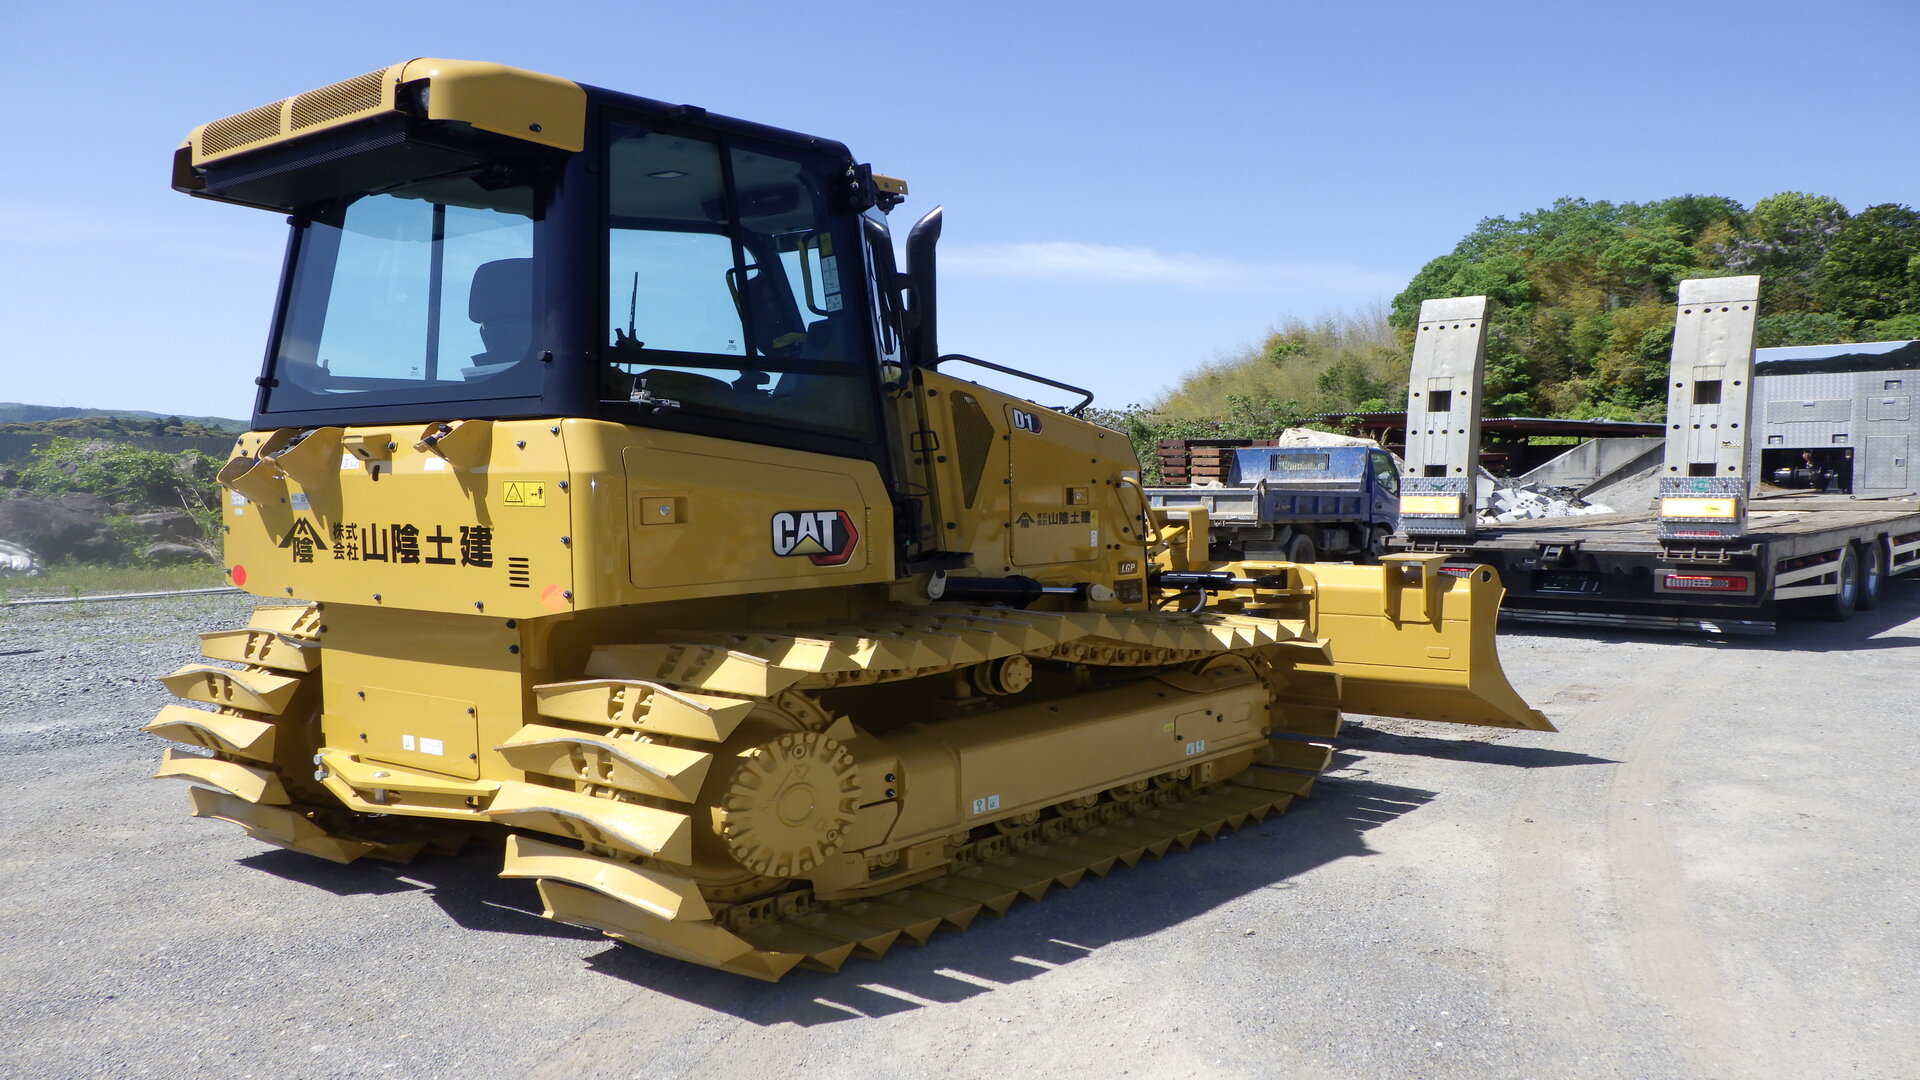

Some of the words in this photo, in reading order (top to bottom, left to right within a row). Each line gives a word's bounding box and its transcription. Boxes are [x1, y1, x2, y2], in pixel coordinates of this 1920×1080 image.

[1012, 408, 1033, 431] D1
[333, 522, 358, 541] 株式
[772, 511, 837, 556] CAT
[292, 537, 314, 563] 陰
[333, 542, 359, 561] 会社
[361, 523, 493, 568] 山陰土建
[1120, 563, 1136, 573] LGP
